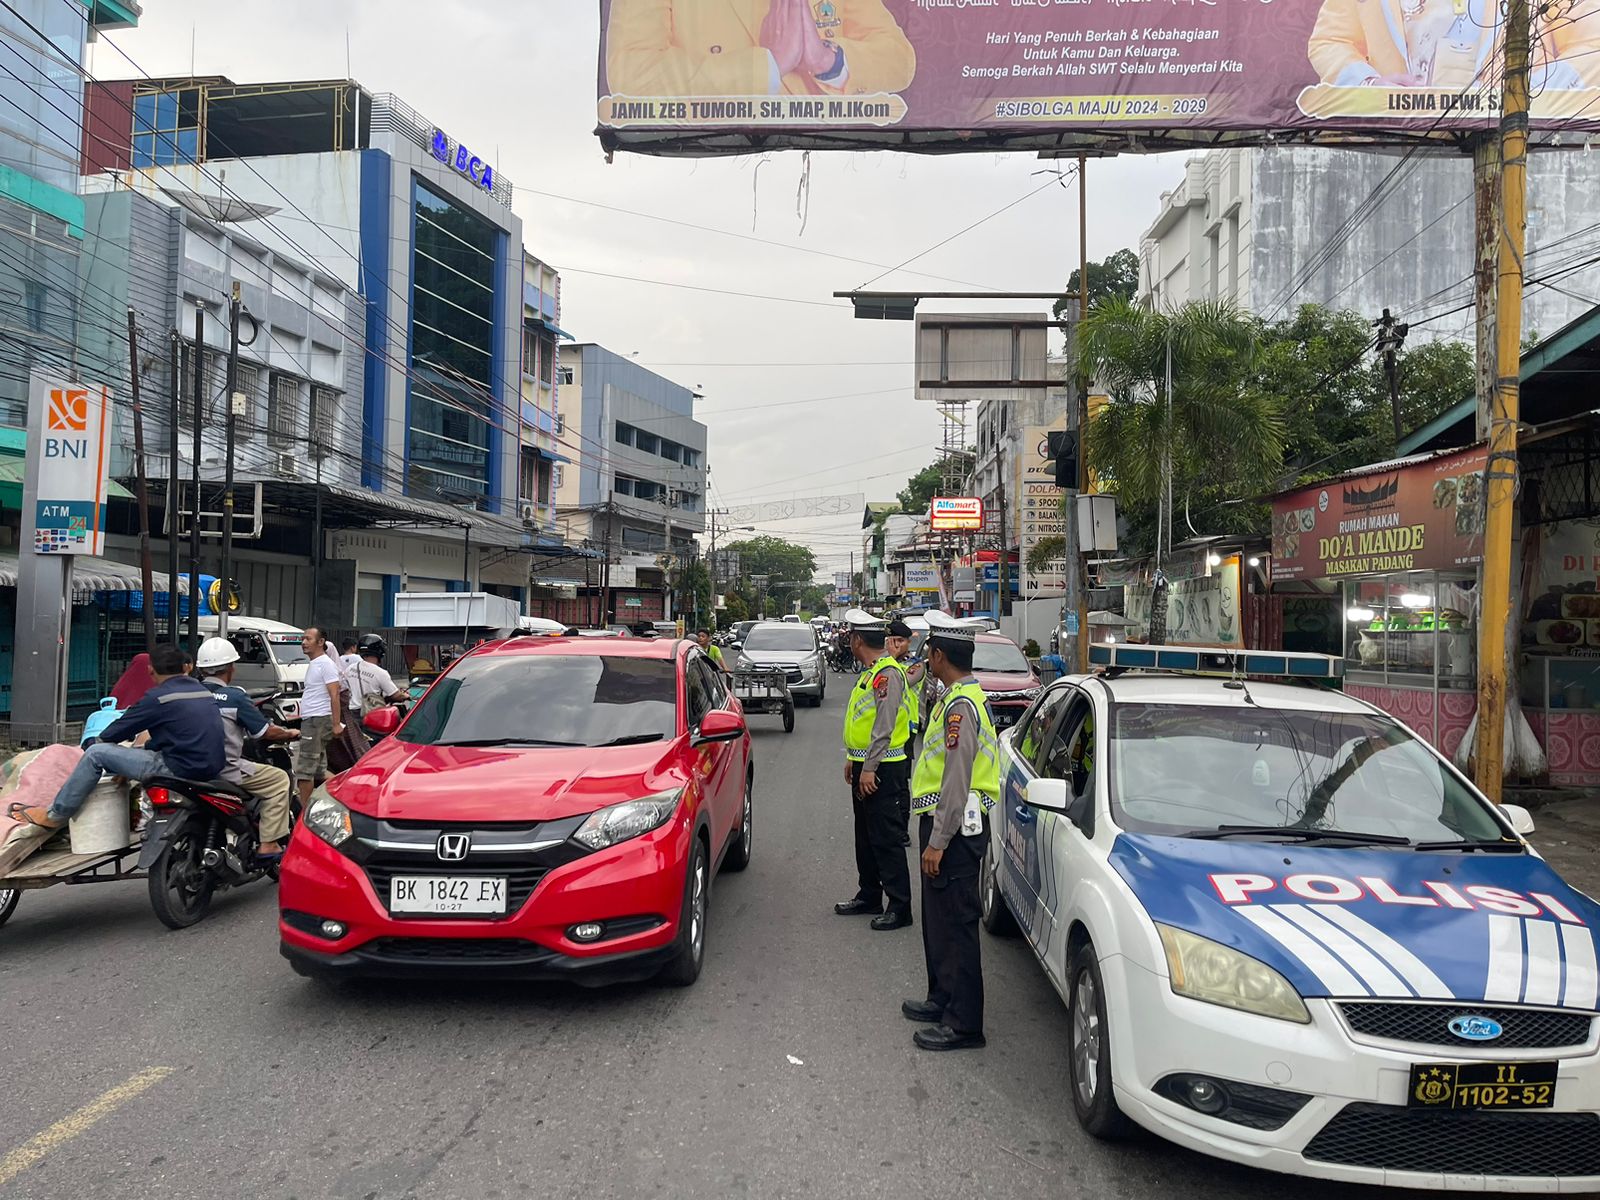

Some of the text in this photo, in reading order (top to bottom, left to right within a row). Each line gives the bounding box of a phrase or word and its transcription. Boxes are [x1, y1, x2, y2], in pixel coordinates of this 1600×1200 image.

[986, 28, 1219, 46] Hari Yang Penuh Berkah & Kebahagiaan
[1023, 45, 1180, 60] Untuk Kamu Dan Keluarga.
[961, 60, 1243, 80] Semoga Berkah Allah SWT Selalu Menyertai Kita
[610, 102, 656, 119] JAMIL
[659, 102, 687, 119] ZEB
[690, 102, 757, 119] TUMORI,
[760, 101, 785, 119] SH,
[789, 101, 825, 119] MAP,
[995, 100, 1074, 118] #SIBOLGA
[1077, 100, 1121, 116] MAJU
[1124, 99, 1159, 115] 2024
[1171, 98, 1207, 115] 2029
[1389, 93, 1436, 111] LISMA
[1440, 93, 1484, 112] DEWI,
[456, 144, 493, 192] BCA
[44, 438, 88, 459] BNI
[1028, 484, 1065, 494] DOLPH
[42, 505, 70, 517] ATM
[936, 501, 976, 509] Alfamart
[68, 516, 87, 531] 24
[1038, 524, 1067, 533] NITROGE
[1339, 512, 1400, 533] RUMAH MAKAN
[1318, 523, 1425, 560] DO'A MANDE
[1325, 553, 1414, 575] MASAKAN PADANG
[1027, 580, 1038, 590] IN
[396, 880, 501, 901] BK 1842 EX
[1207, 873, 1586, 925] POLISI
[1459, 1085, 1550, 1106] 1102-52
